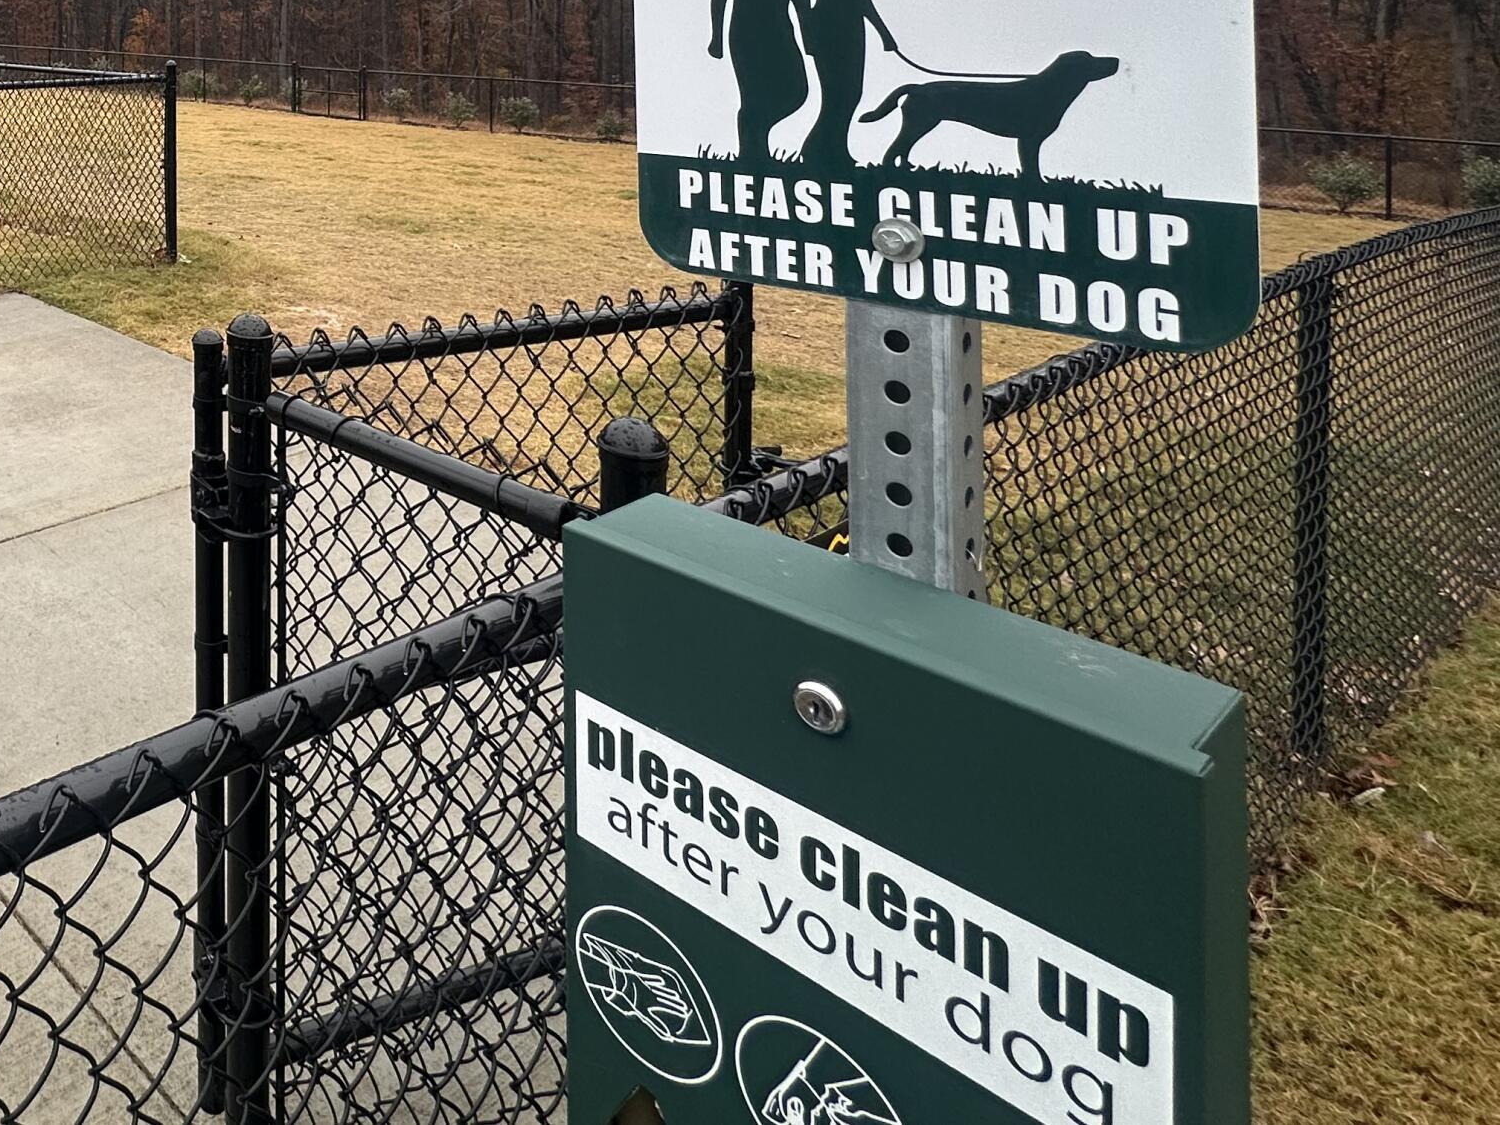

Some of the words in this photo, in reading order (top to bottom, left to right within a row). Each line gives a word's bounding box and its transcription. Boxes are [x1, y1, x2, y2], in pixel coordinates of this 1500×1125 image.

[679, 169, 855, 228] PLEASE
[879, 187, 1066, 254] CLEAN
[1096, 207, 1189, 266] UP
[688, 228, 834, 286] AFTER
[855, 248, 1010, 315] YOUR
[1039, 274, 1181, 343] DOG
[587, 718, 780, 861] please
[800, 834, 1009, 995] clean
[1038, 957, 1150, 1069] up
[607, 795, 740, 897] after
[758, 879, 918, 1005] your
[945, 993, 1115, 1125] dog
